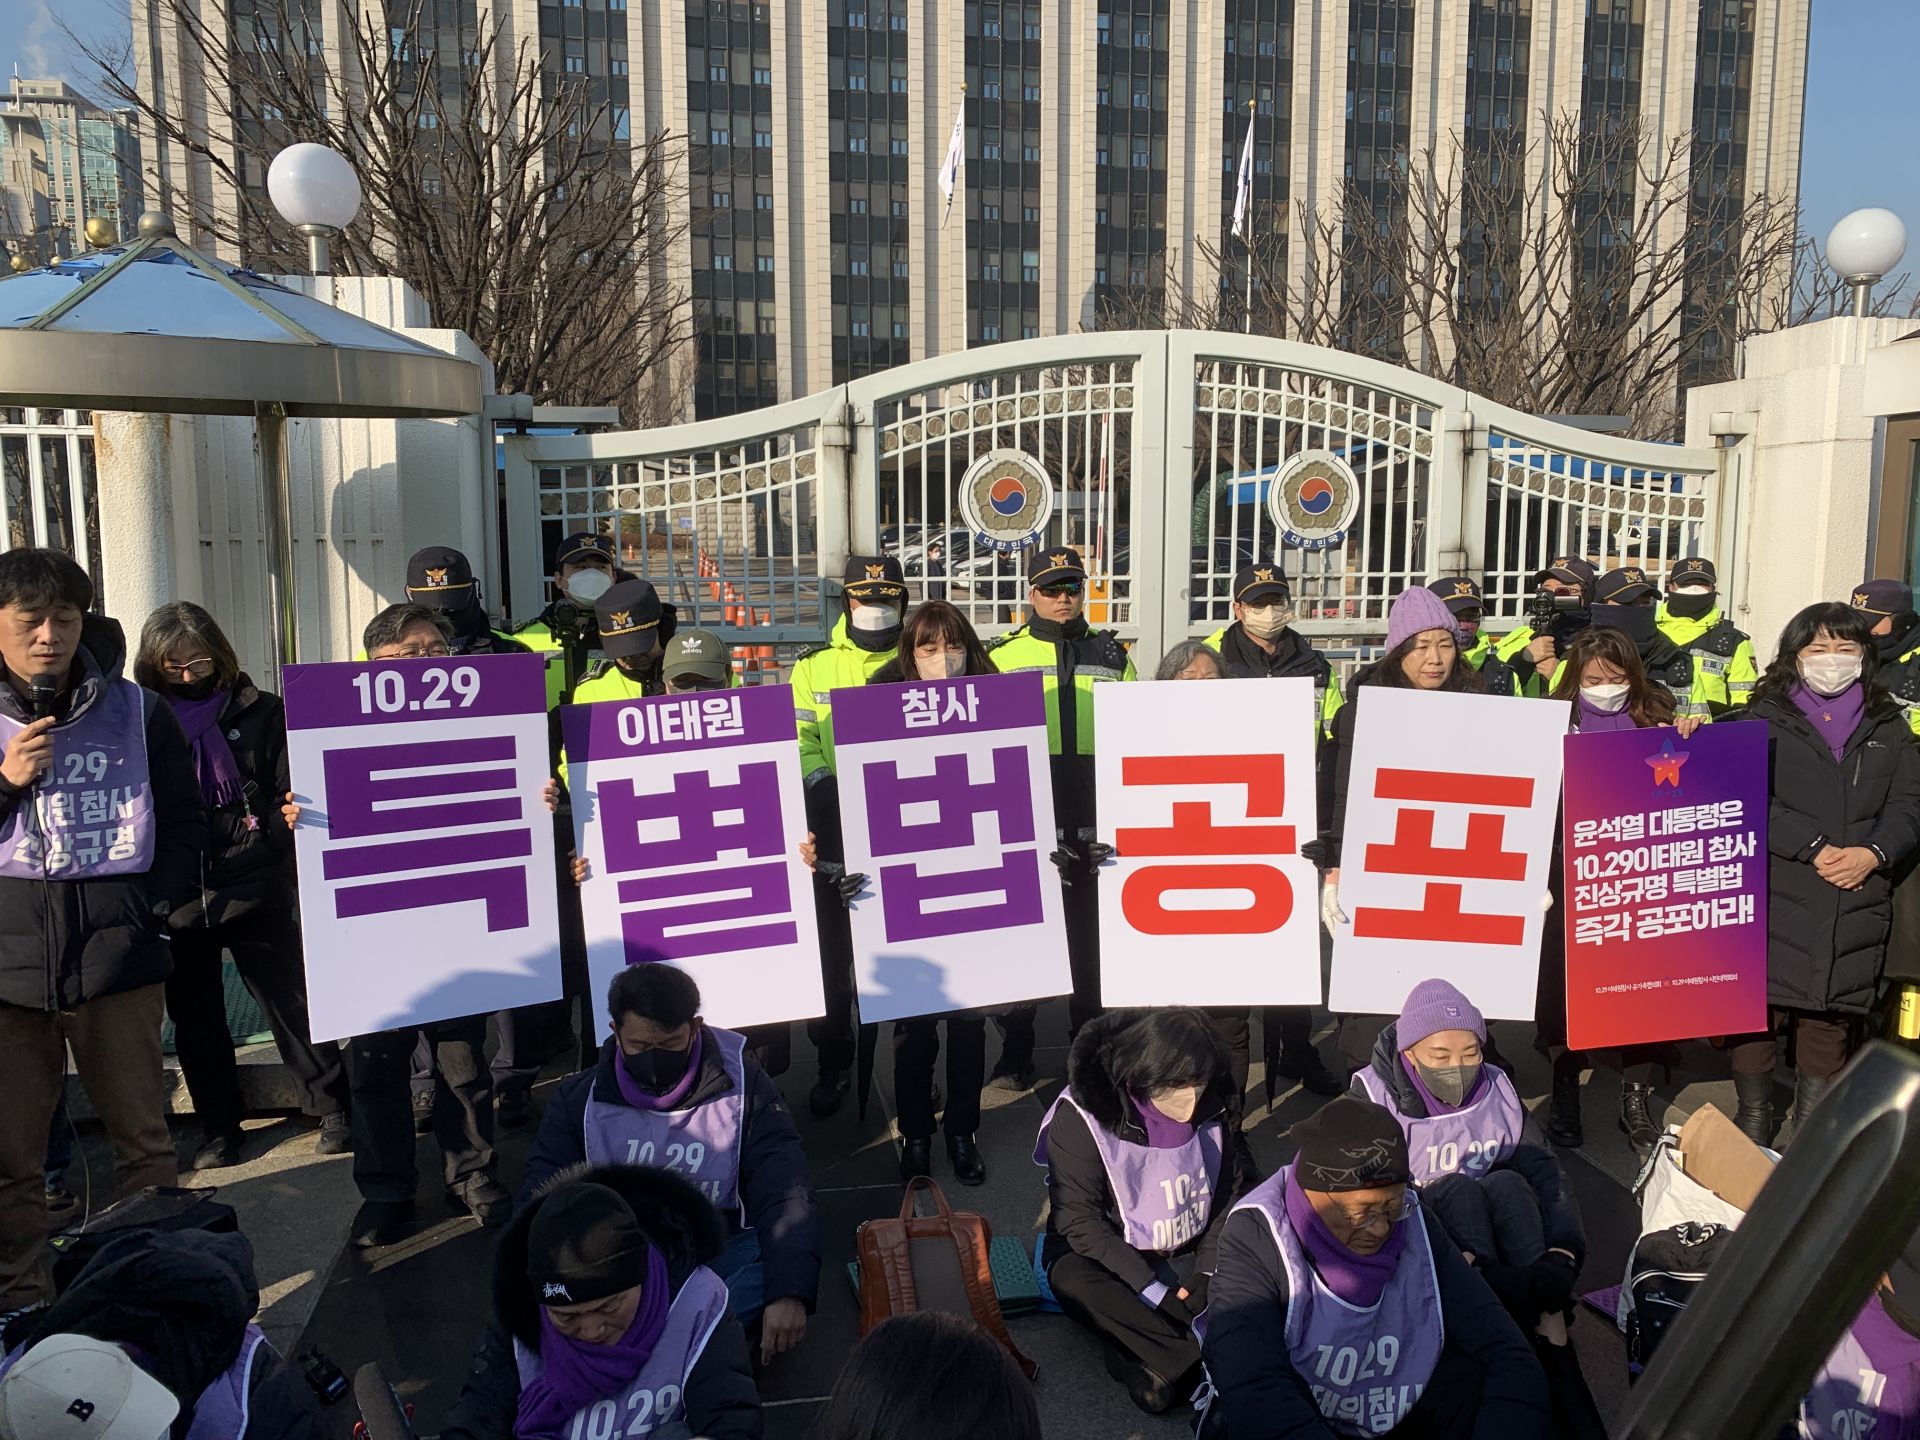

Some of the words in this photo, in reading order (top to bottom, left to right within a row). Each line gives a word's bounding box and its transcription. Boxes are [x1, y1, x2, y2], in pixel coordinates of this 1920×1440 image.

[983, 536, 1034, 550] 대한민국
[1291, 534, 1339, 548] 대한민국
[353, 667, 480, 713] 10.29
[902, 684, 979, 728] 참사
[617, 696, 745, 746] 이태원
[80, 786, 134, 825] 참사
[1574, 812, 1645, 848] 윤석열
[1650, 800, 1744, 837] 대통령은
[12, 825, 136, 869] 진상규명
[323, 736, 531, 932] 특
[863, 745, 1045, 943] 법
[1116, 754, 1297, 935] 공
[1353, 767, 1535, 946] 포
[1708, 831, 1757, 863] 참사
[597, 761, 798, 965] 별
[1574, 873, 1668, 912] 진상규명
[1673, 863, 1743, 896] 특별법
[1575, 911, 1632, 946] 즉각
[1636, 894, 1755, 940] 공포하라!
[626, 1139, 705, 1174] 1029
[66, 1398, 95, 1422] B
[570, 1384, 681, 1440] 10.29
[1309, 1384, 1365, 1427] 태원
[1367, 1383, 1424, 1433] 참사
